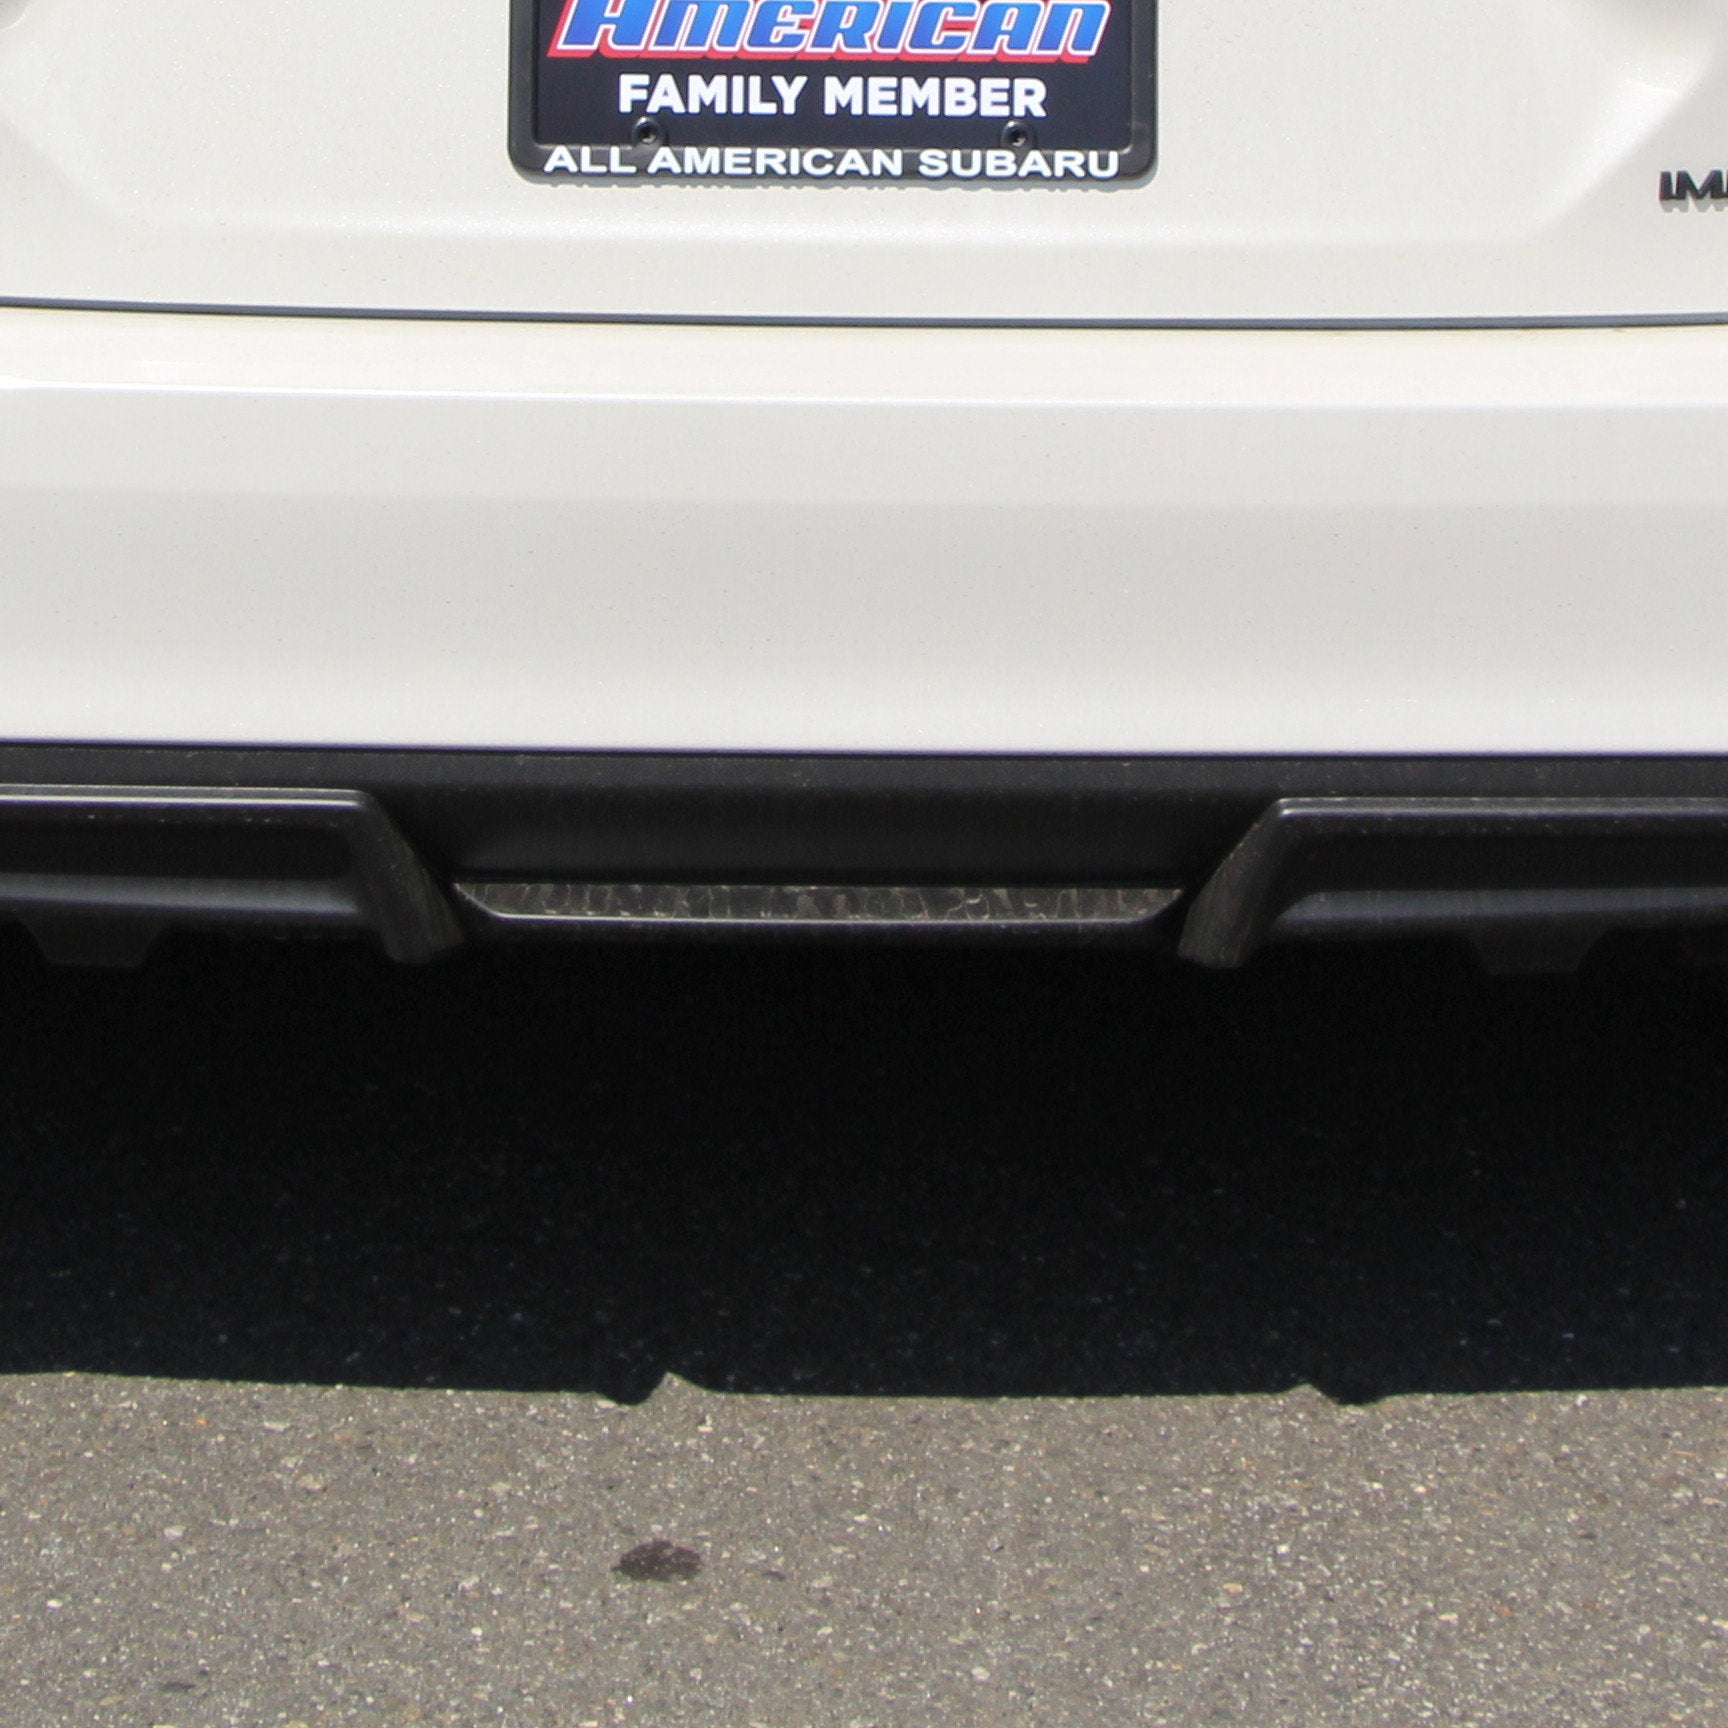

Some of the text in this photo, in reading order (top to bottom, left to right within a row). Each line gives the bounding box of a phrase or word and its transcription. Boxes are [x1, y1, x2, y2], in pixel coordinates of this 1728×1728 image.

[619, 74, 1047, 118] FAMILY MEMBER
[543, 146, 1120, 178] ALL AMERICAN SUBARU
